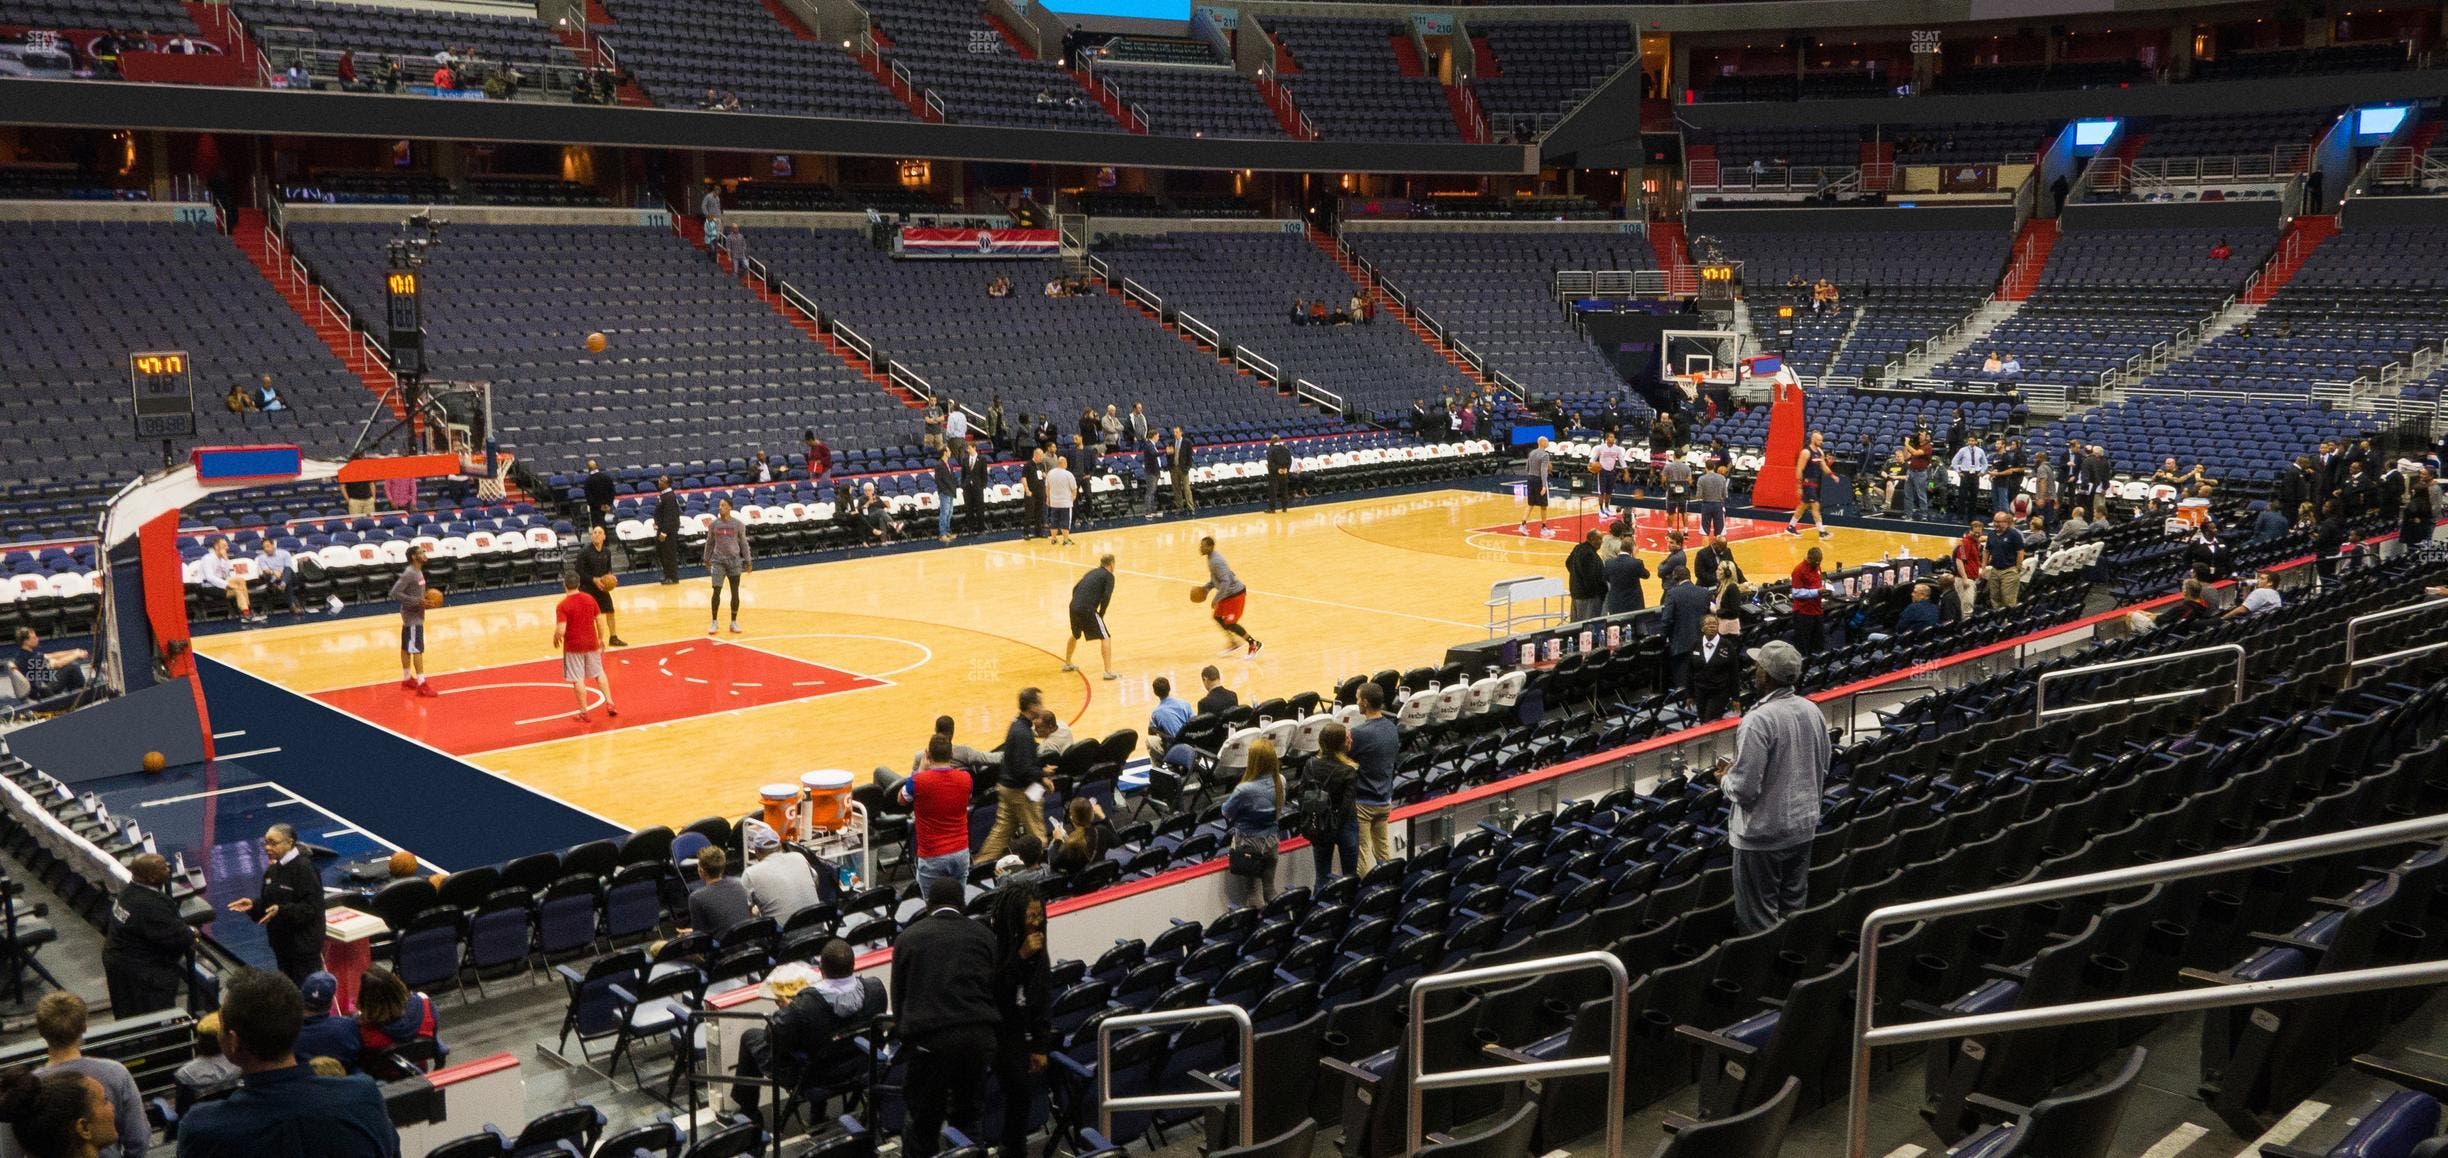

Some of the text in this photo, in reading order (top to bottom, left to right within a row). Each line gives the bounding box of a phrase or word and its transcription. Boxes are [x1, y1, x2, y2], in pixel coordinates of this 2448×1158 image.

[1436, 24, 1452, 33] 210
[182, 209, 207, 222] 112
[648, 215, 664, 226] 111
[1284, 224, 1301, 233] 109
[1623, 224, 1641, 233] 108
[785, 805, 796, 820] G
